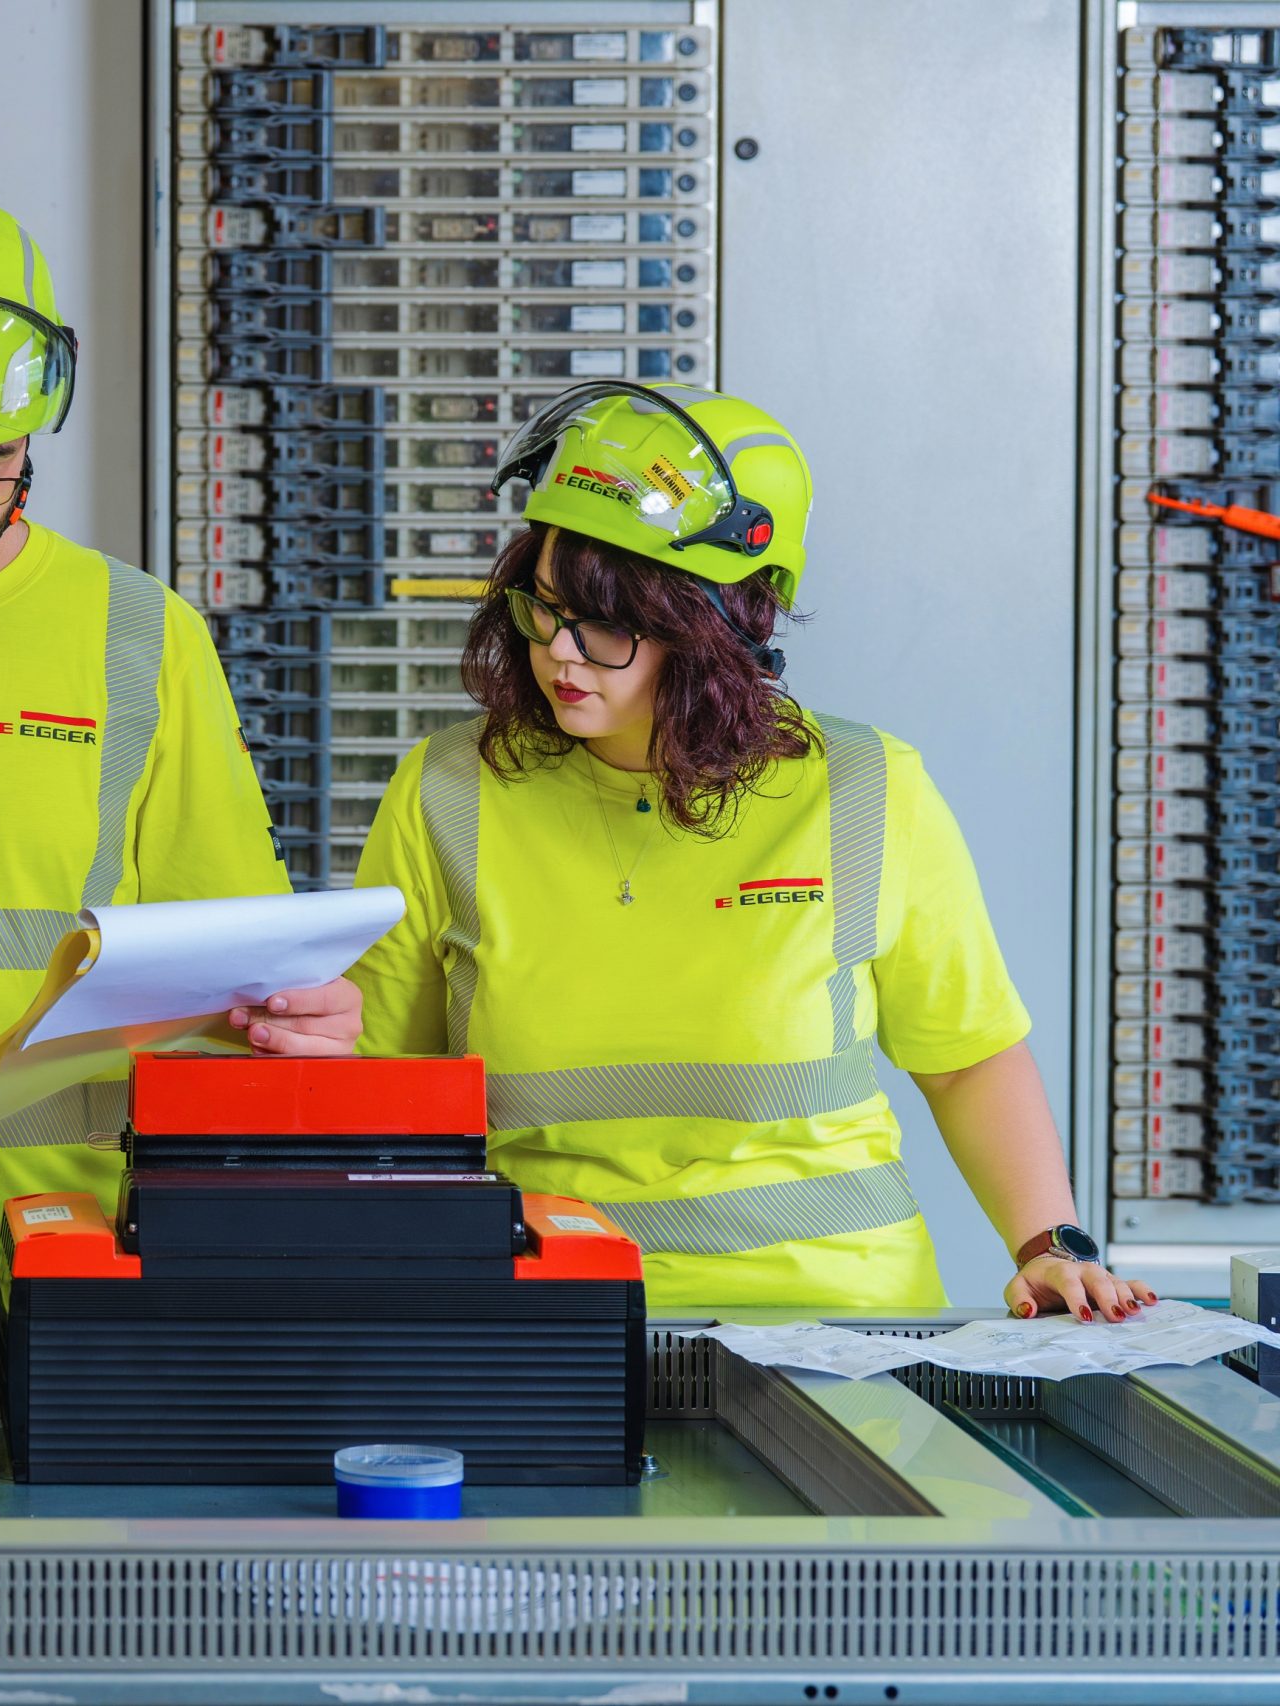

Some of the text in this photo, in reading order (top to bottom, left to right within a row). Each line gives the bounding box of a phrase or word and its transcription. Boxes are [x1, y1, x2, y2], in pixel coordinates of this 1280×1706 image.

[554, 473, 632, 505] E EGGER
[651, 463, 685, 501] WARNING
[20, 724, 96, 745] EGGER
[715, 890, 824, 908] E EGGER
